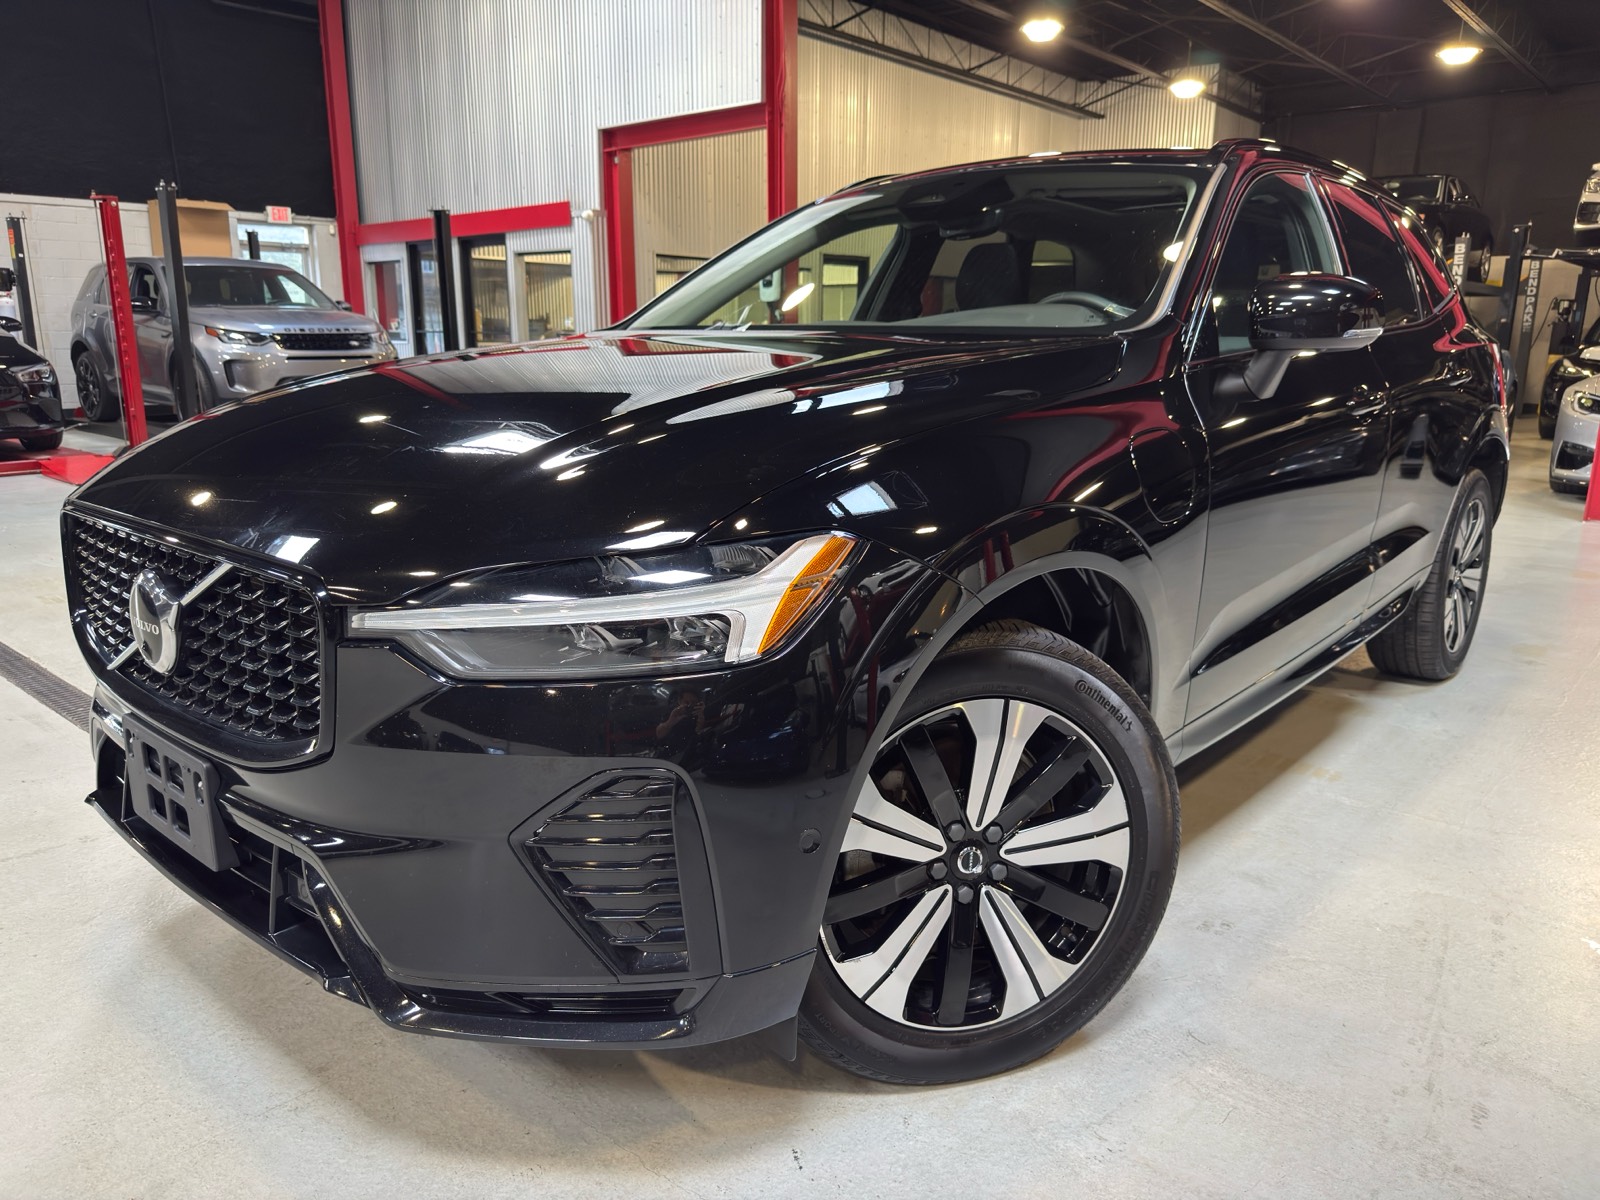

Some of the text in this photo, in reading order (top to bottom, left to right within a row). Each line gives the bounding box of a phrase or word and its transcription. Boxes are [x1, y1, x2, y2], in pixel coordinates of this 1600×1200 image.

[271, 206, 289, 221] EXIT
[1523, 260, 1540, 322] BENDPAK
[1074, 680, 1128, 726] Continental
